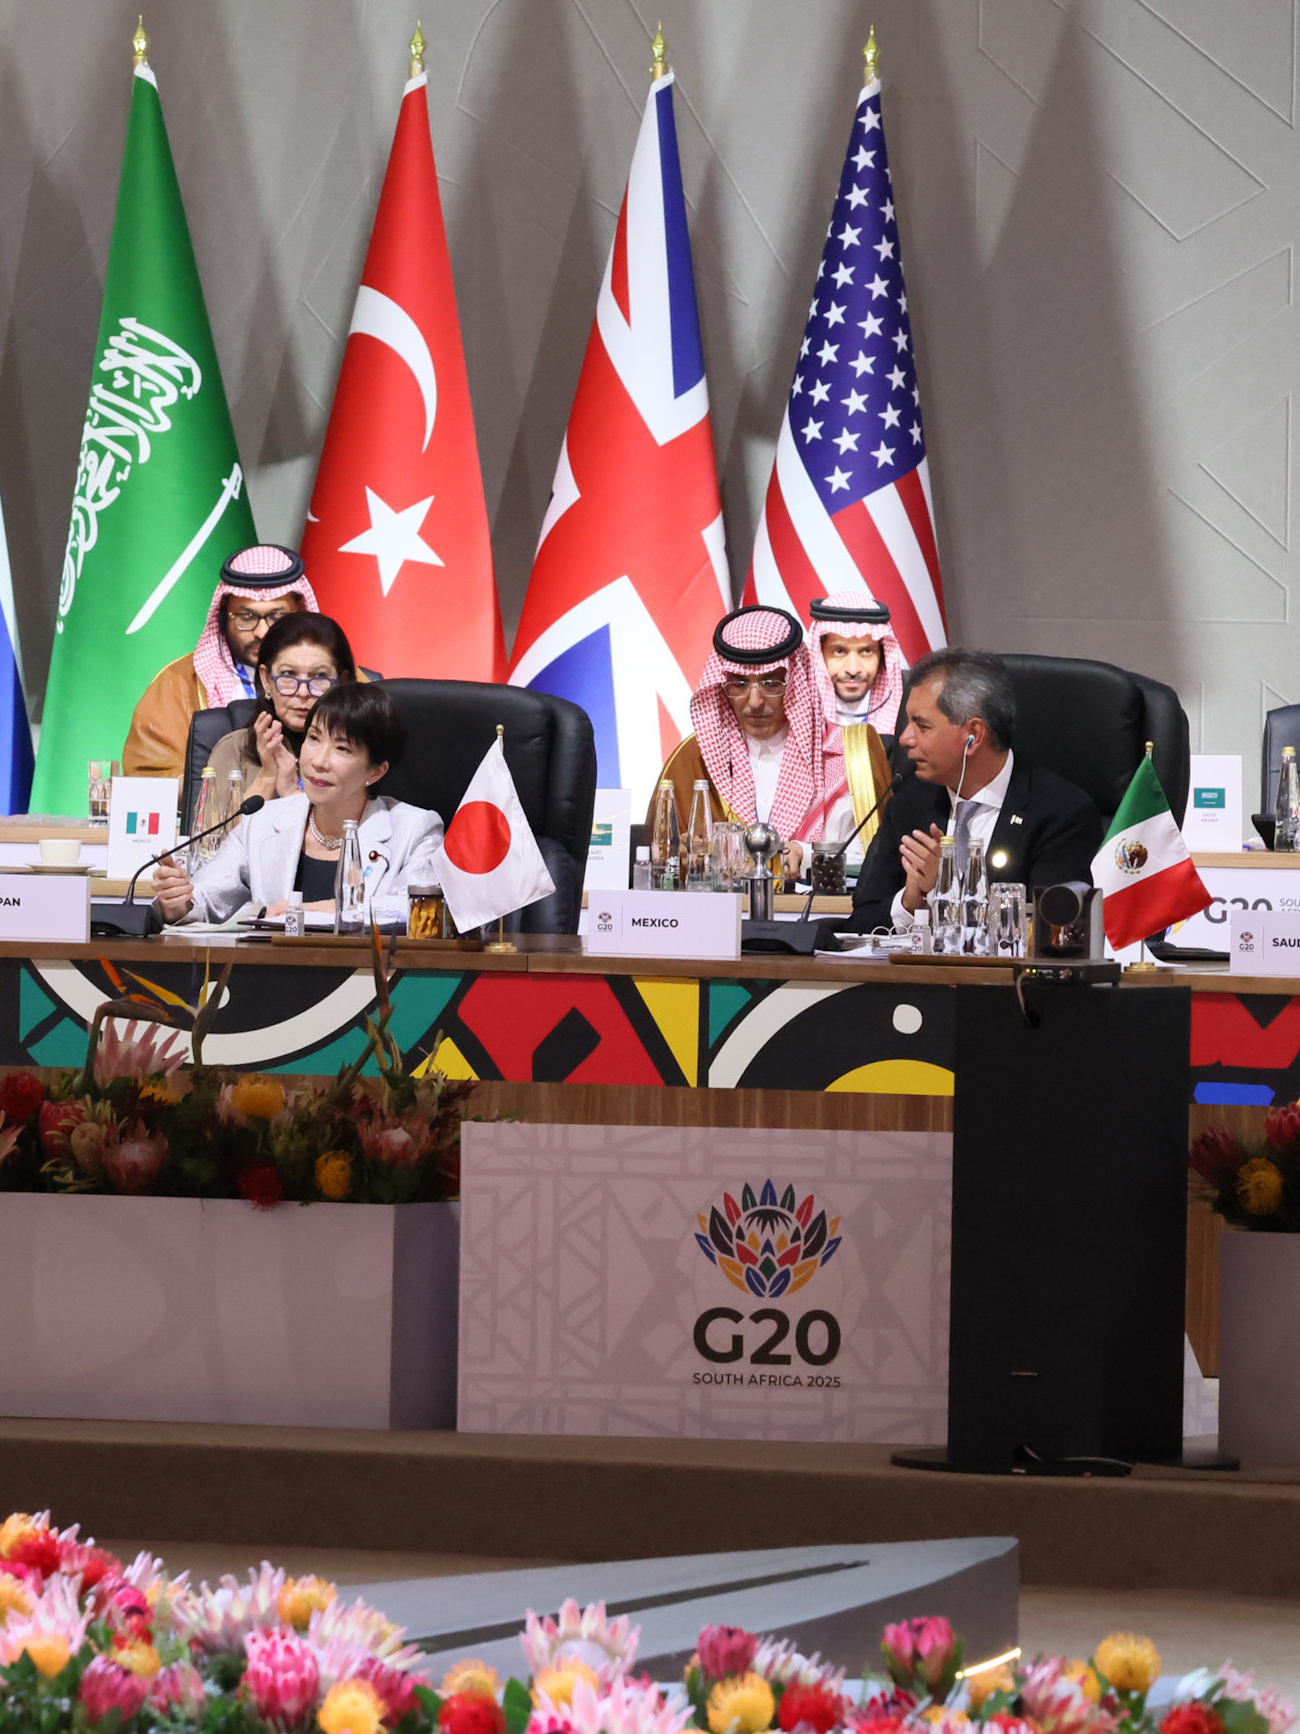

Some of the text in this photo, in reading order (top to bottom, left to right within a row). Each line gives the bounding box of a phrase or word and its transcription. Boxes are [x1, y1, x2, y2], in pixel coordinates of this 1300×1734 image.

[631, 918, 679, 928] MEXICO
[1239, 943, 1255, 951] G20
[693, 1306, 842, 1366] G20
[692, 1372, 842, 1388] SOUTH AFRICA 2025
